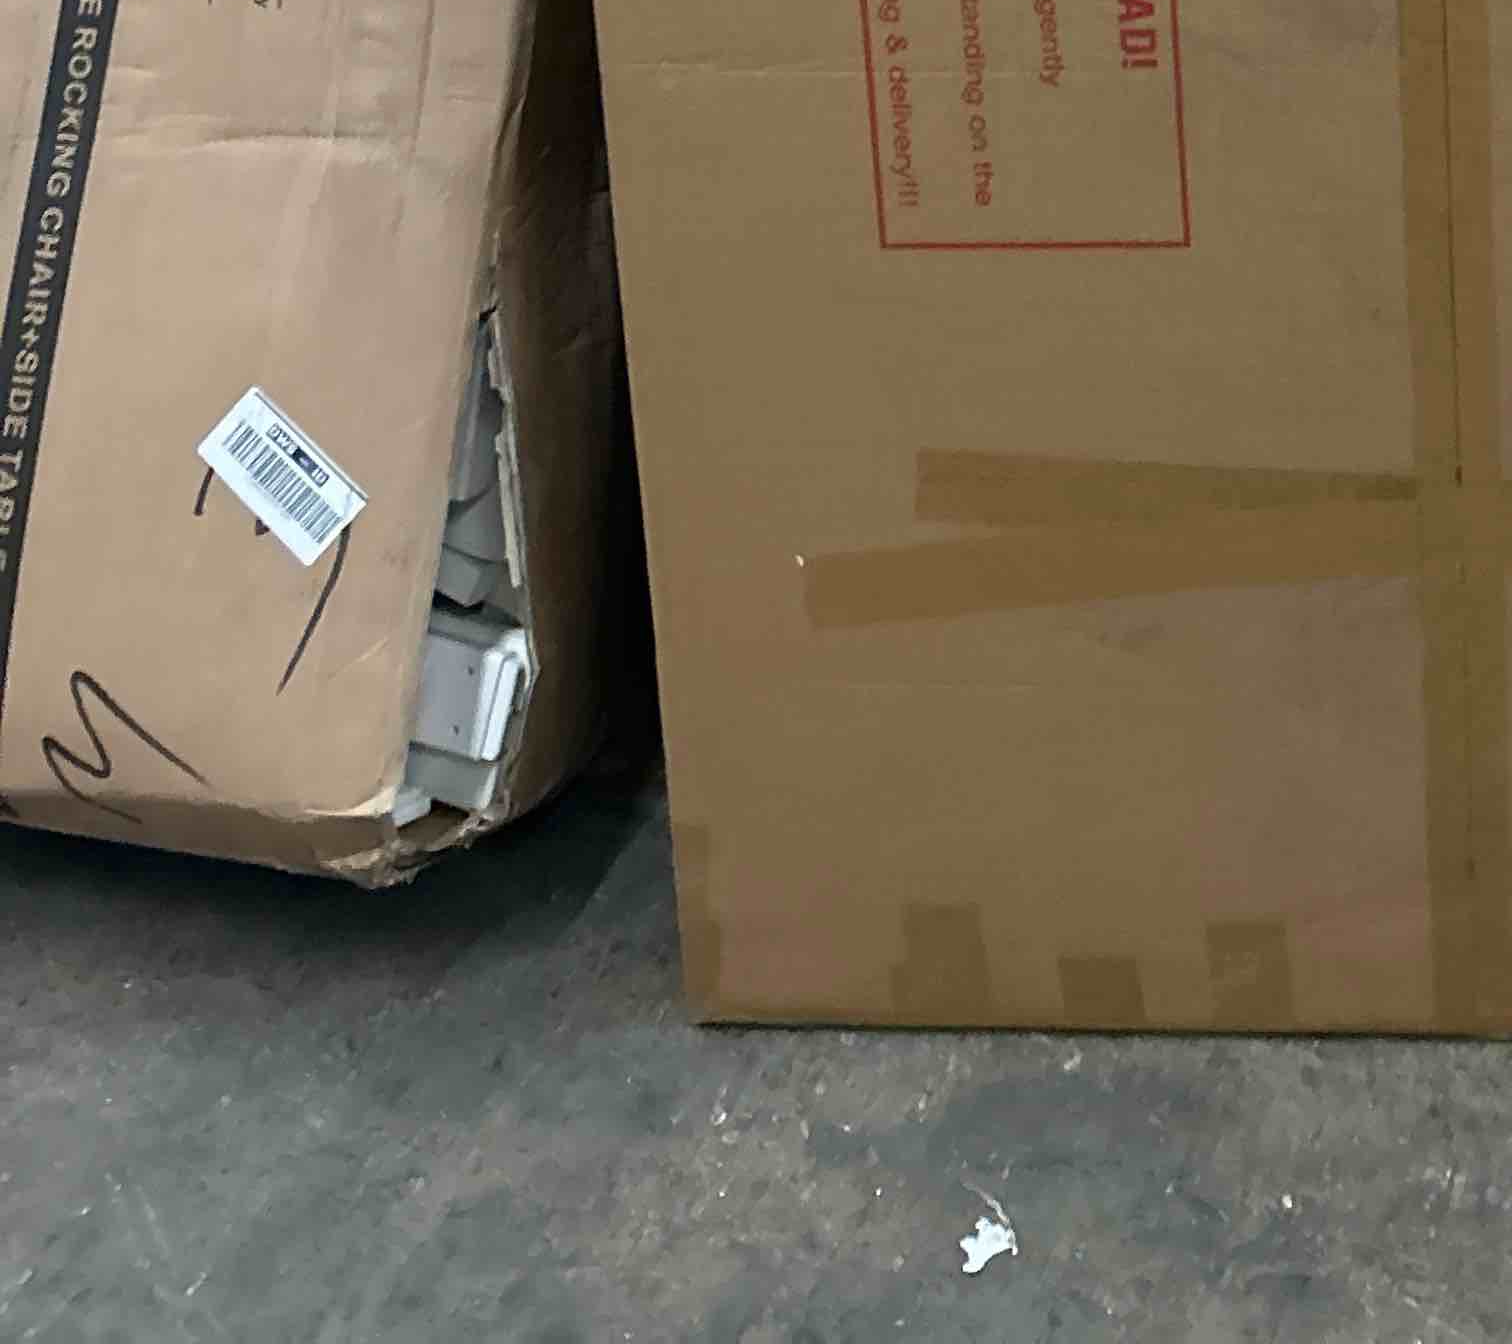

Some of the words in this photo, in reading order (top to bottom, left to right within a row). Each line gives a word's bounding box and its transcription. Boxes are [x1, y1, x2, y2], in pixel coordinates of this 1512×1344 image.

[45, 26, 97, 200] ROCKING
[968, 116, 988, 153] on
[973, 162, 993, 208] the
[1, 205, 64, 440] CHAIR+SIDE
